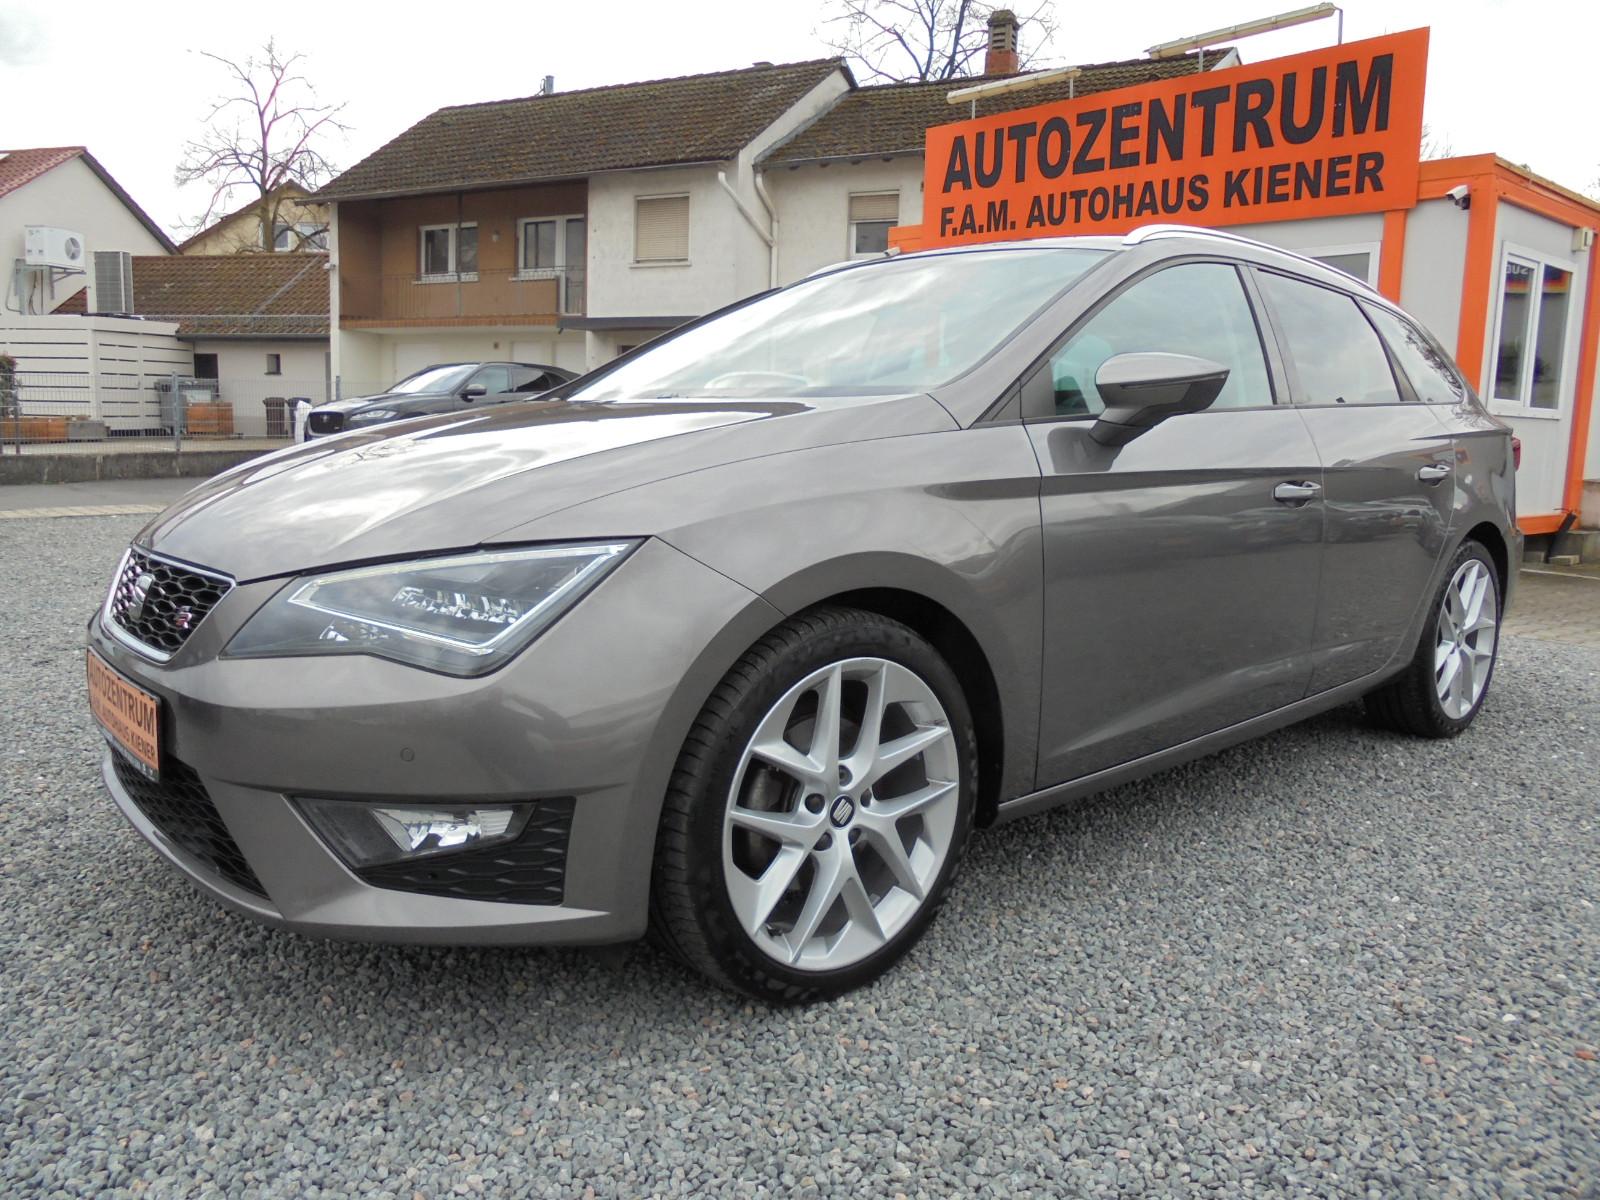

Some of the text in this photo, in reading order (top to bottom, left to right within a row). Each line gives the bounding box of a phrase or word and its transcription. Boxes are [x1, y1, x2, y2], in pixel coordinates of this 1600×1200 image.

[942, 54, 1394, 193] AUTOZENTRUM
[940, 151, 1385, 237] F.A.M. AUTOHAUS KIENER
